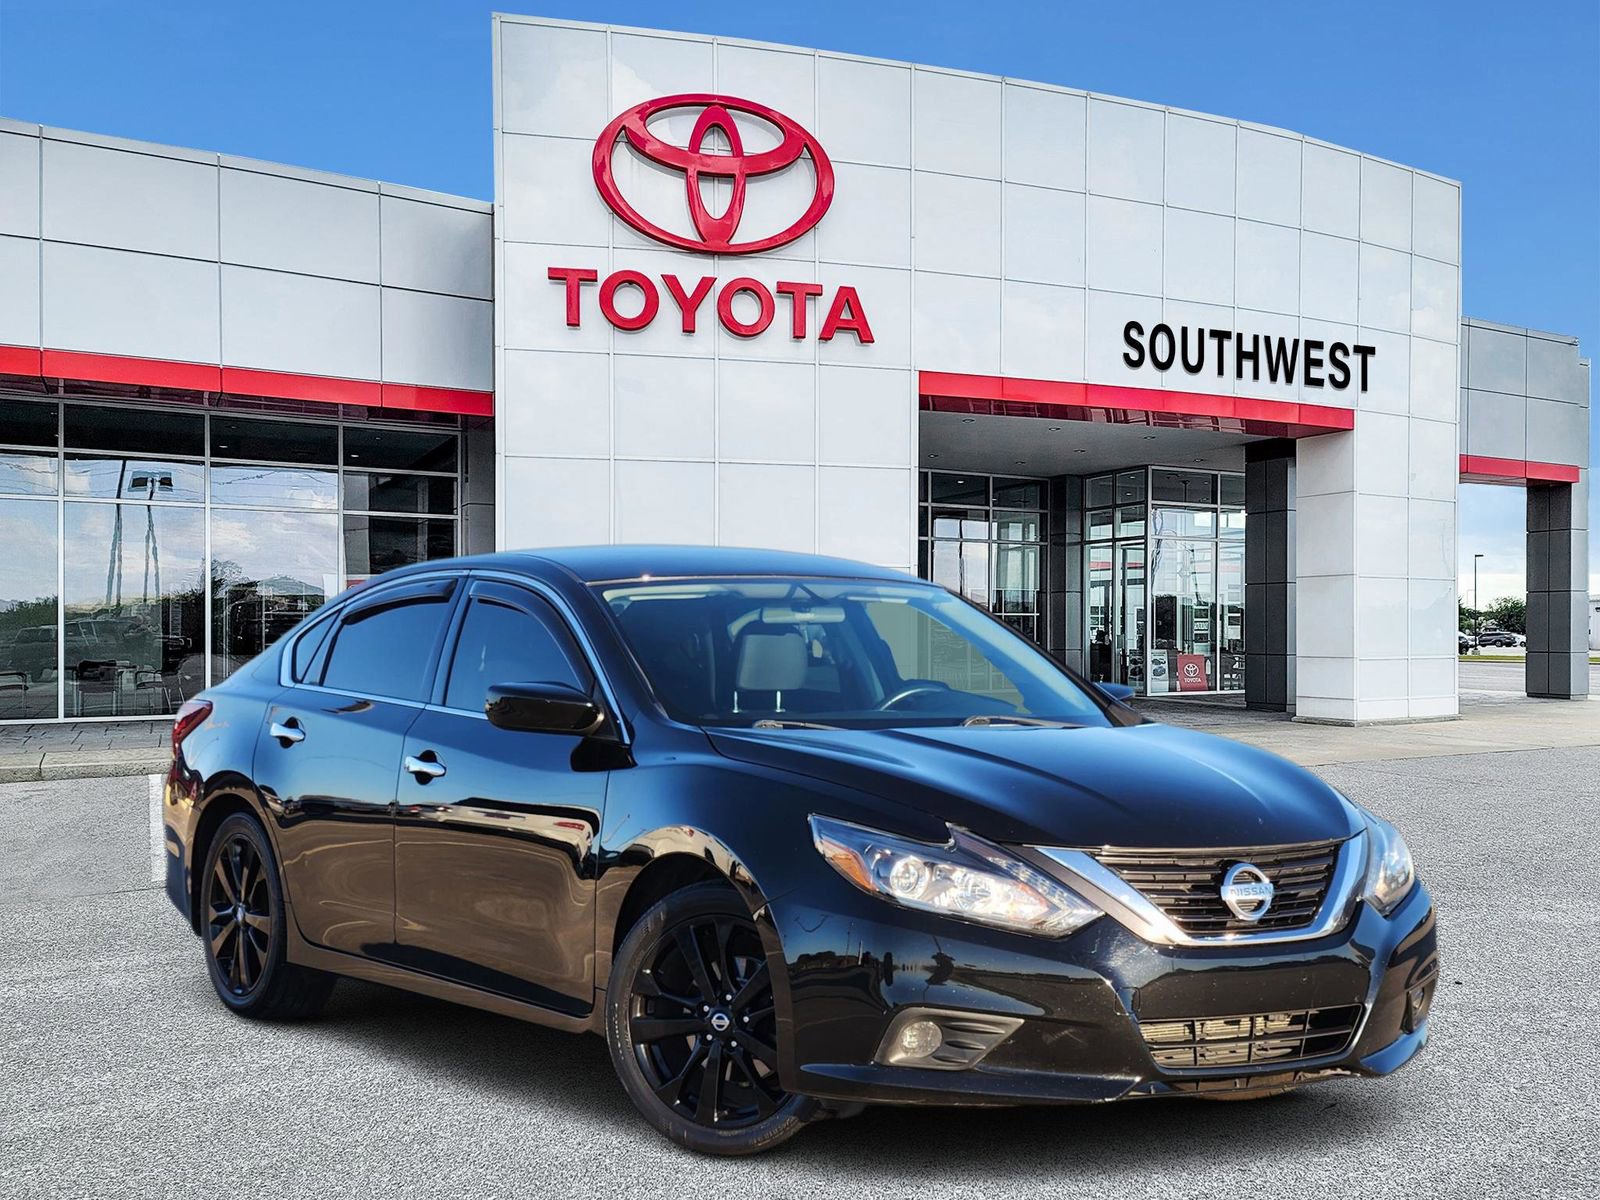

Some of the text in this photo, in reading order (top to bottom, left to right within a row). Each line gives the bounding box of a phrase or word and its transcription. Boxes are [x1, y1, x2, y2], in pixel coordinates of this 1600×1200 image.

[547, 267, 875, 344] TOYOTA
[1122, 320, 1376, 392] SOUTHWEST
[1230, 887, 1273, 897] NISSAN
